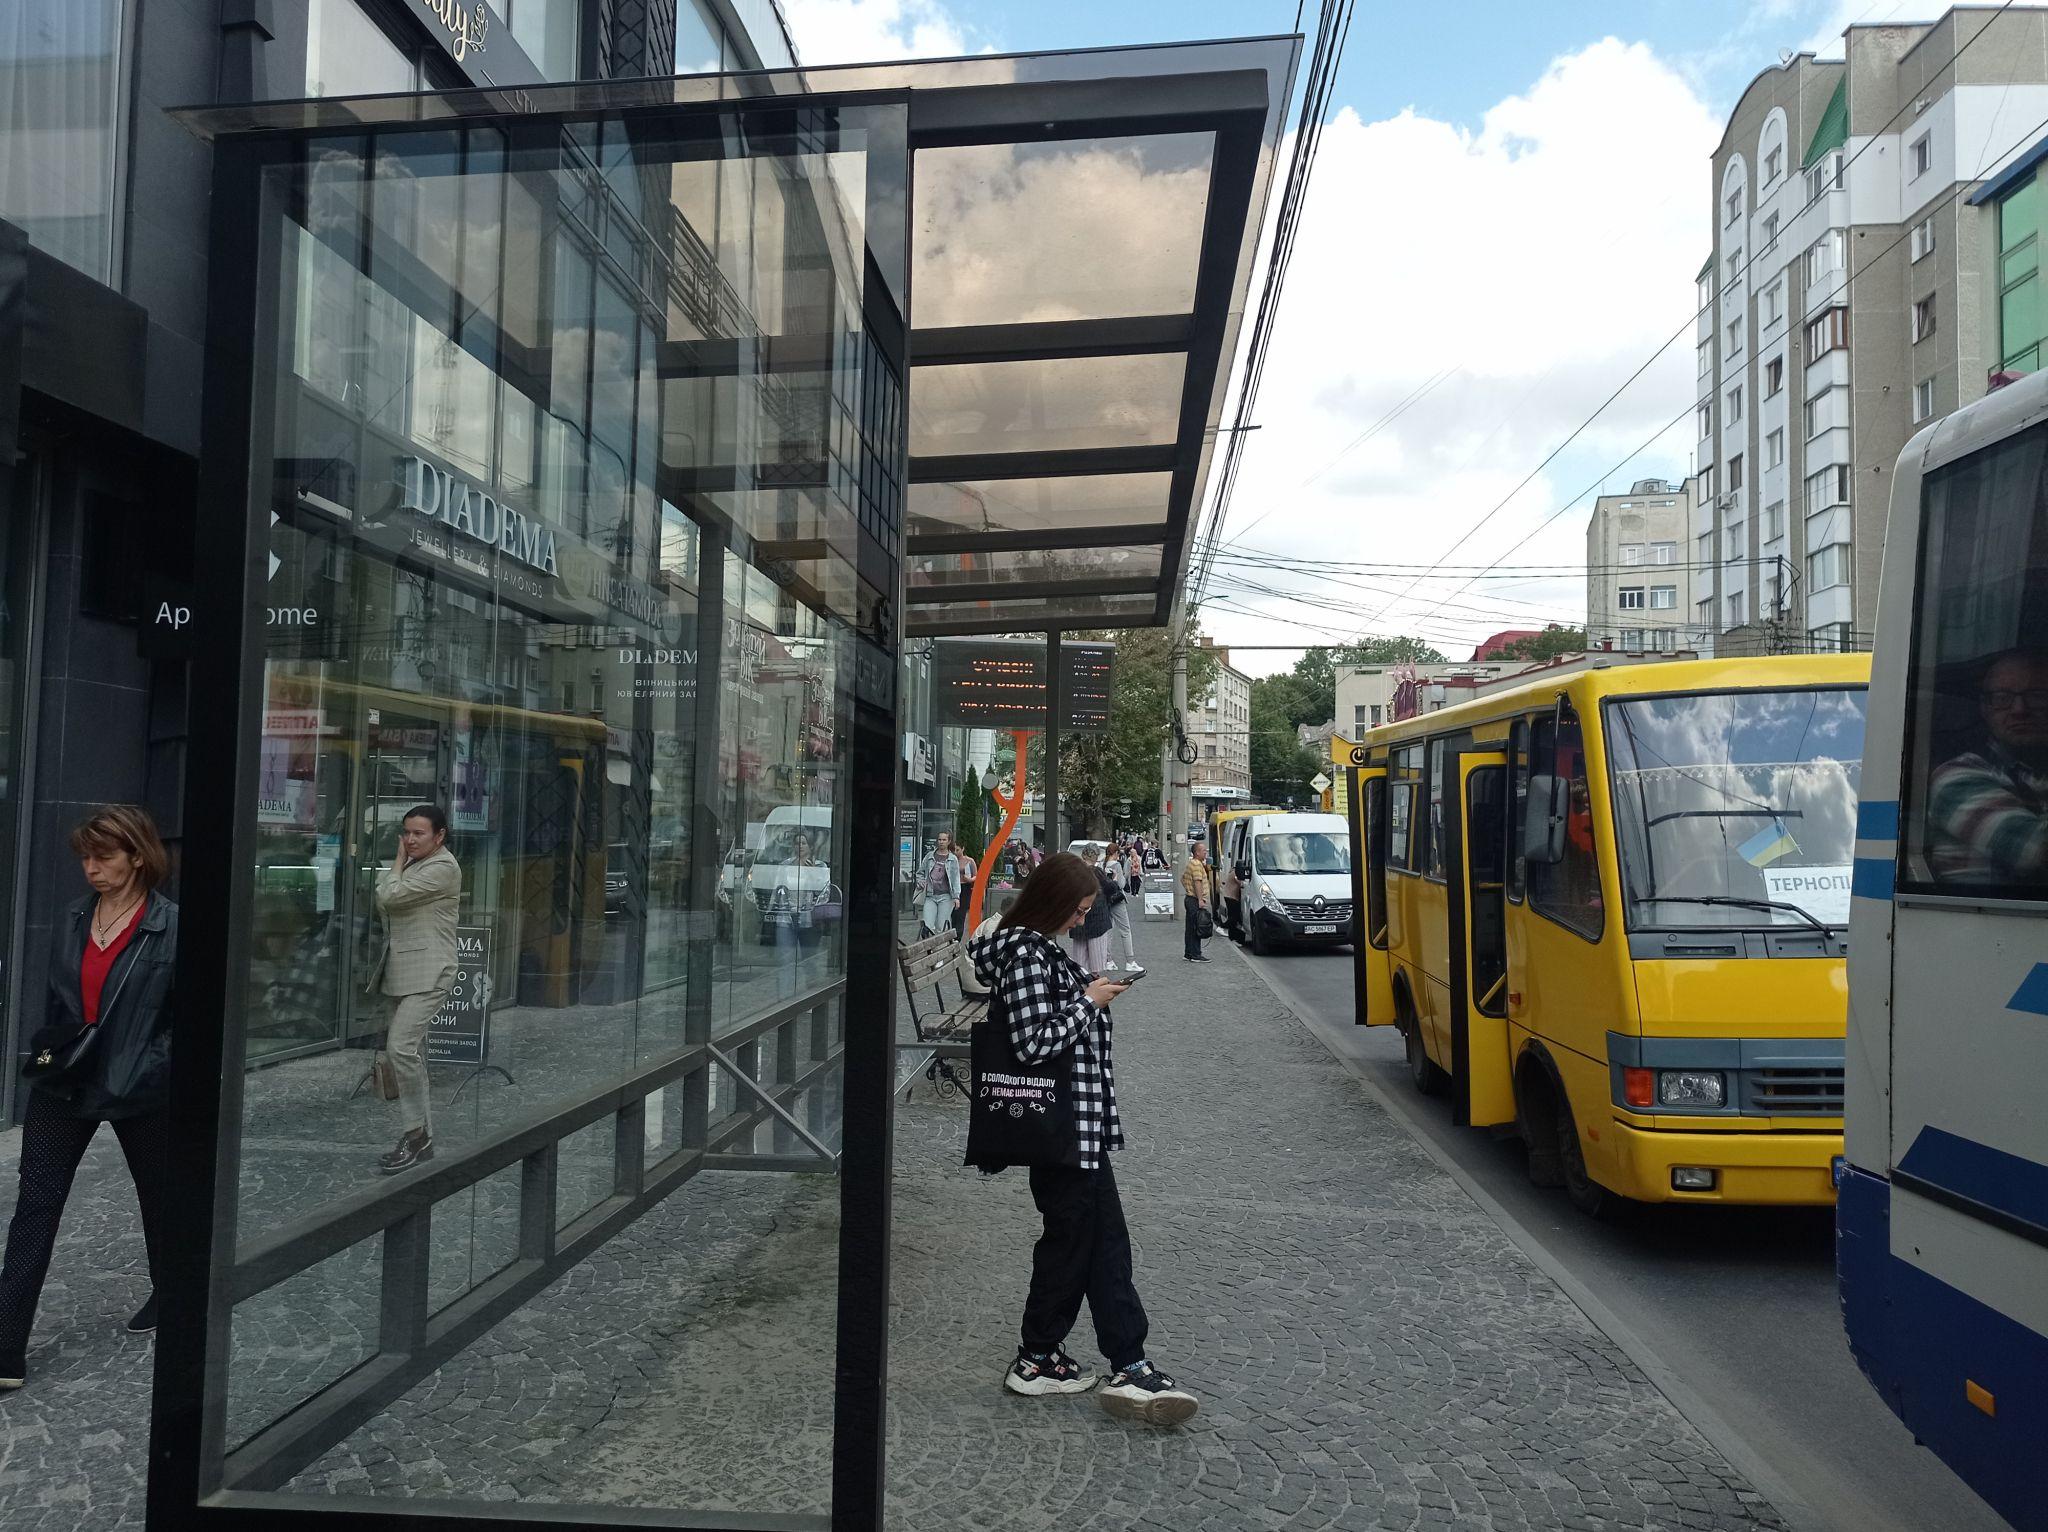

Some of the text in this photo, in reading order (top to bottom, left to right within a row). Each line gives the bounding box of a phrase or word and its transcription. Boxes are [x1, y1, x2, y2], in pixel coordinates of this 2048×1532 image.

[411, 455, 559, 578] DIADEMA
[409, 527, 544, 599] JEWELLERY & DIAMONDS
[155, 601, 317, 630] Ap ome
[619, 649, 698, 664] DIADEM
[258, 800, 292, 813] ADEMA
[1770, 875, 1851, 892] ТЕРНОПІ
[981, 1072, 1056, 1088] В СОЛОДКОГО ВІДДІЛУ
[991, 1087, 1042, 1099] НЕМАЄ ШАНСІВ
